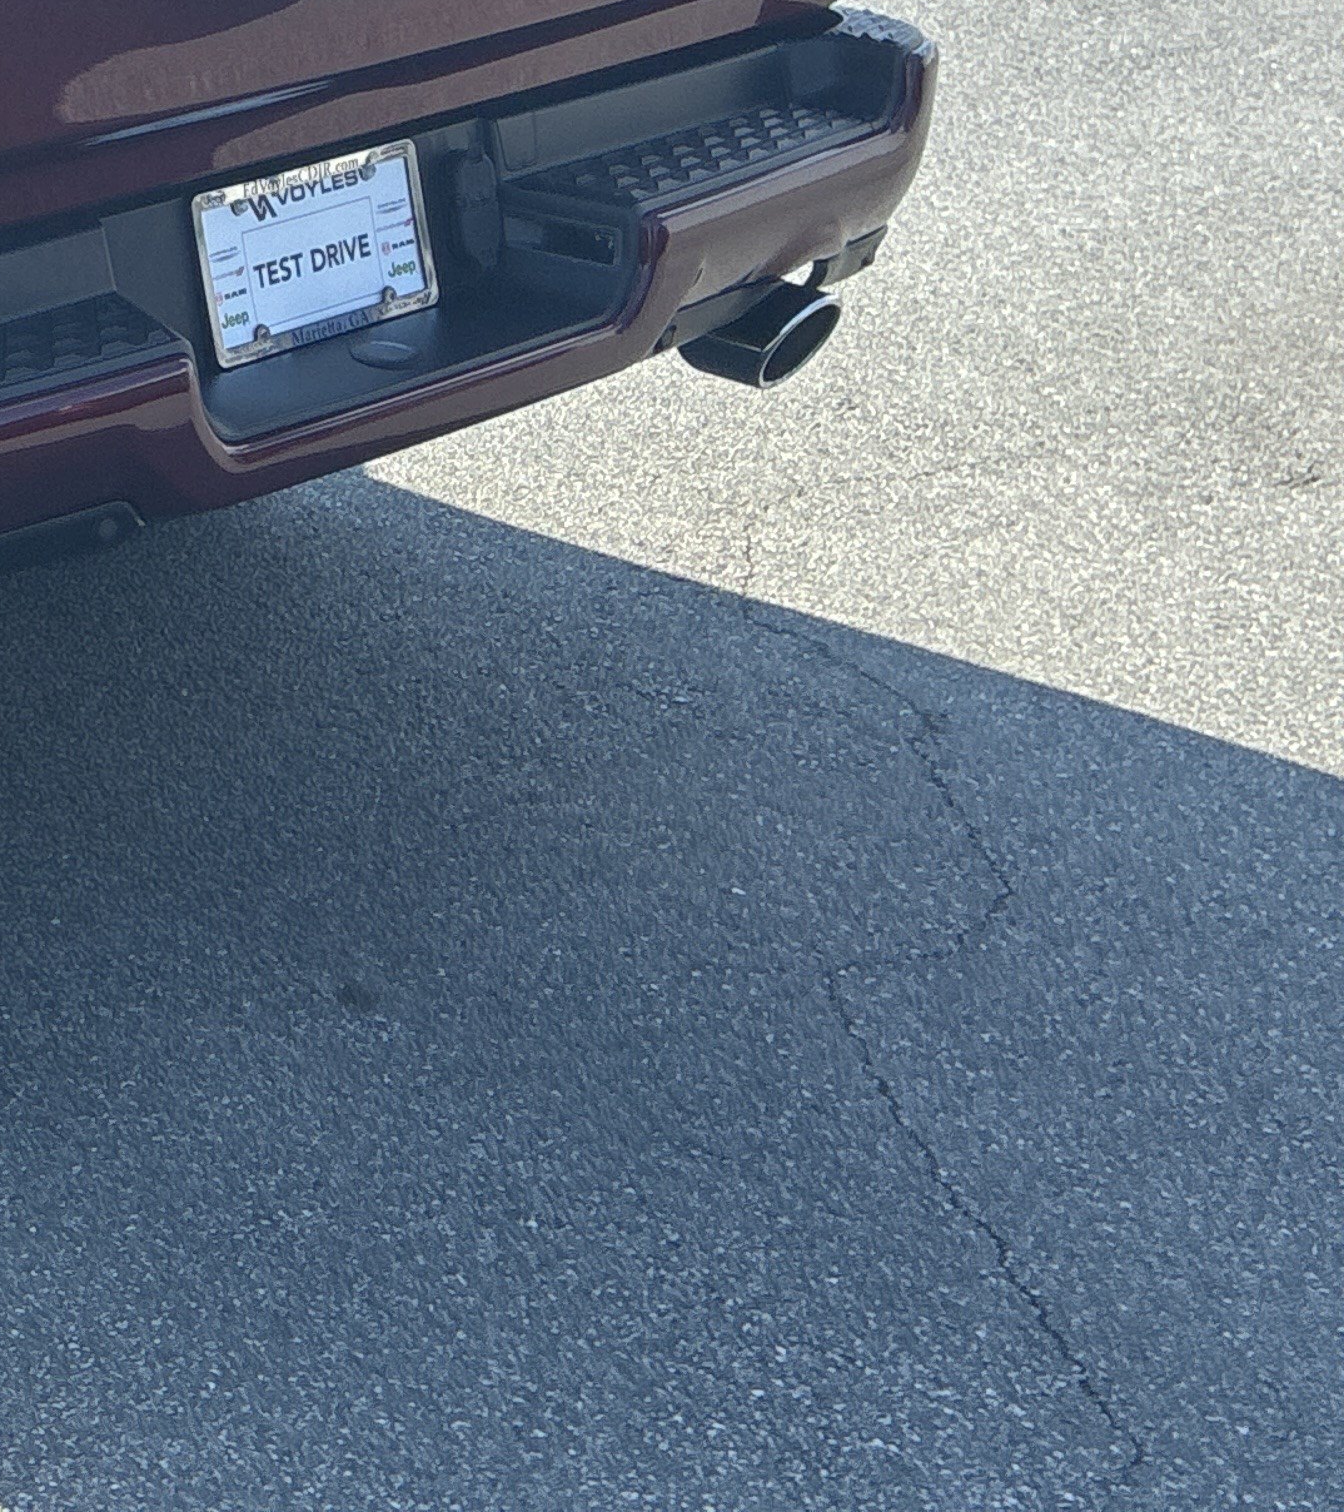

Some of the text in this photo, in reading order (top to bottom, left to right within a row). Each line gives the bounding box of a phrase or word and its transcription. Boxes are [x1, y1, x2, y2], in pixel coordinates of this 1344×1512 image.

[274, 169, 359, 206] VOYLES
[253, 233, 372, 289] TEST DRIVE
[387, 259, 416, 278] Jeep
[221, 310, 250, 329] Jeep
